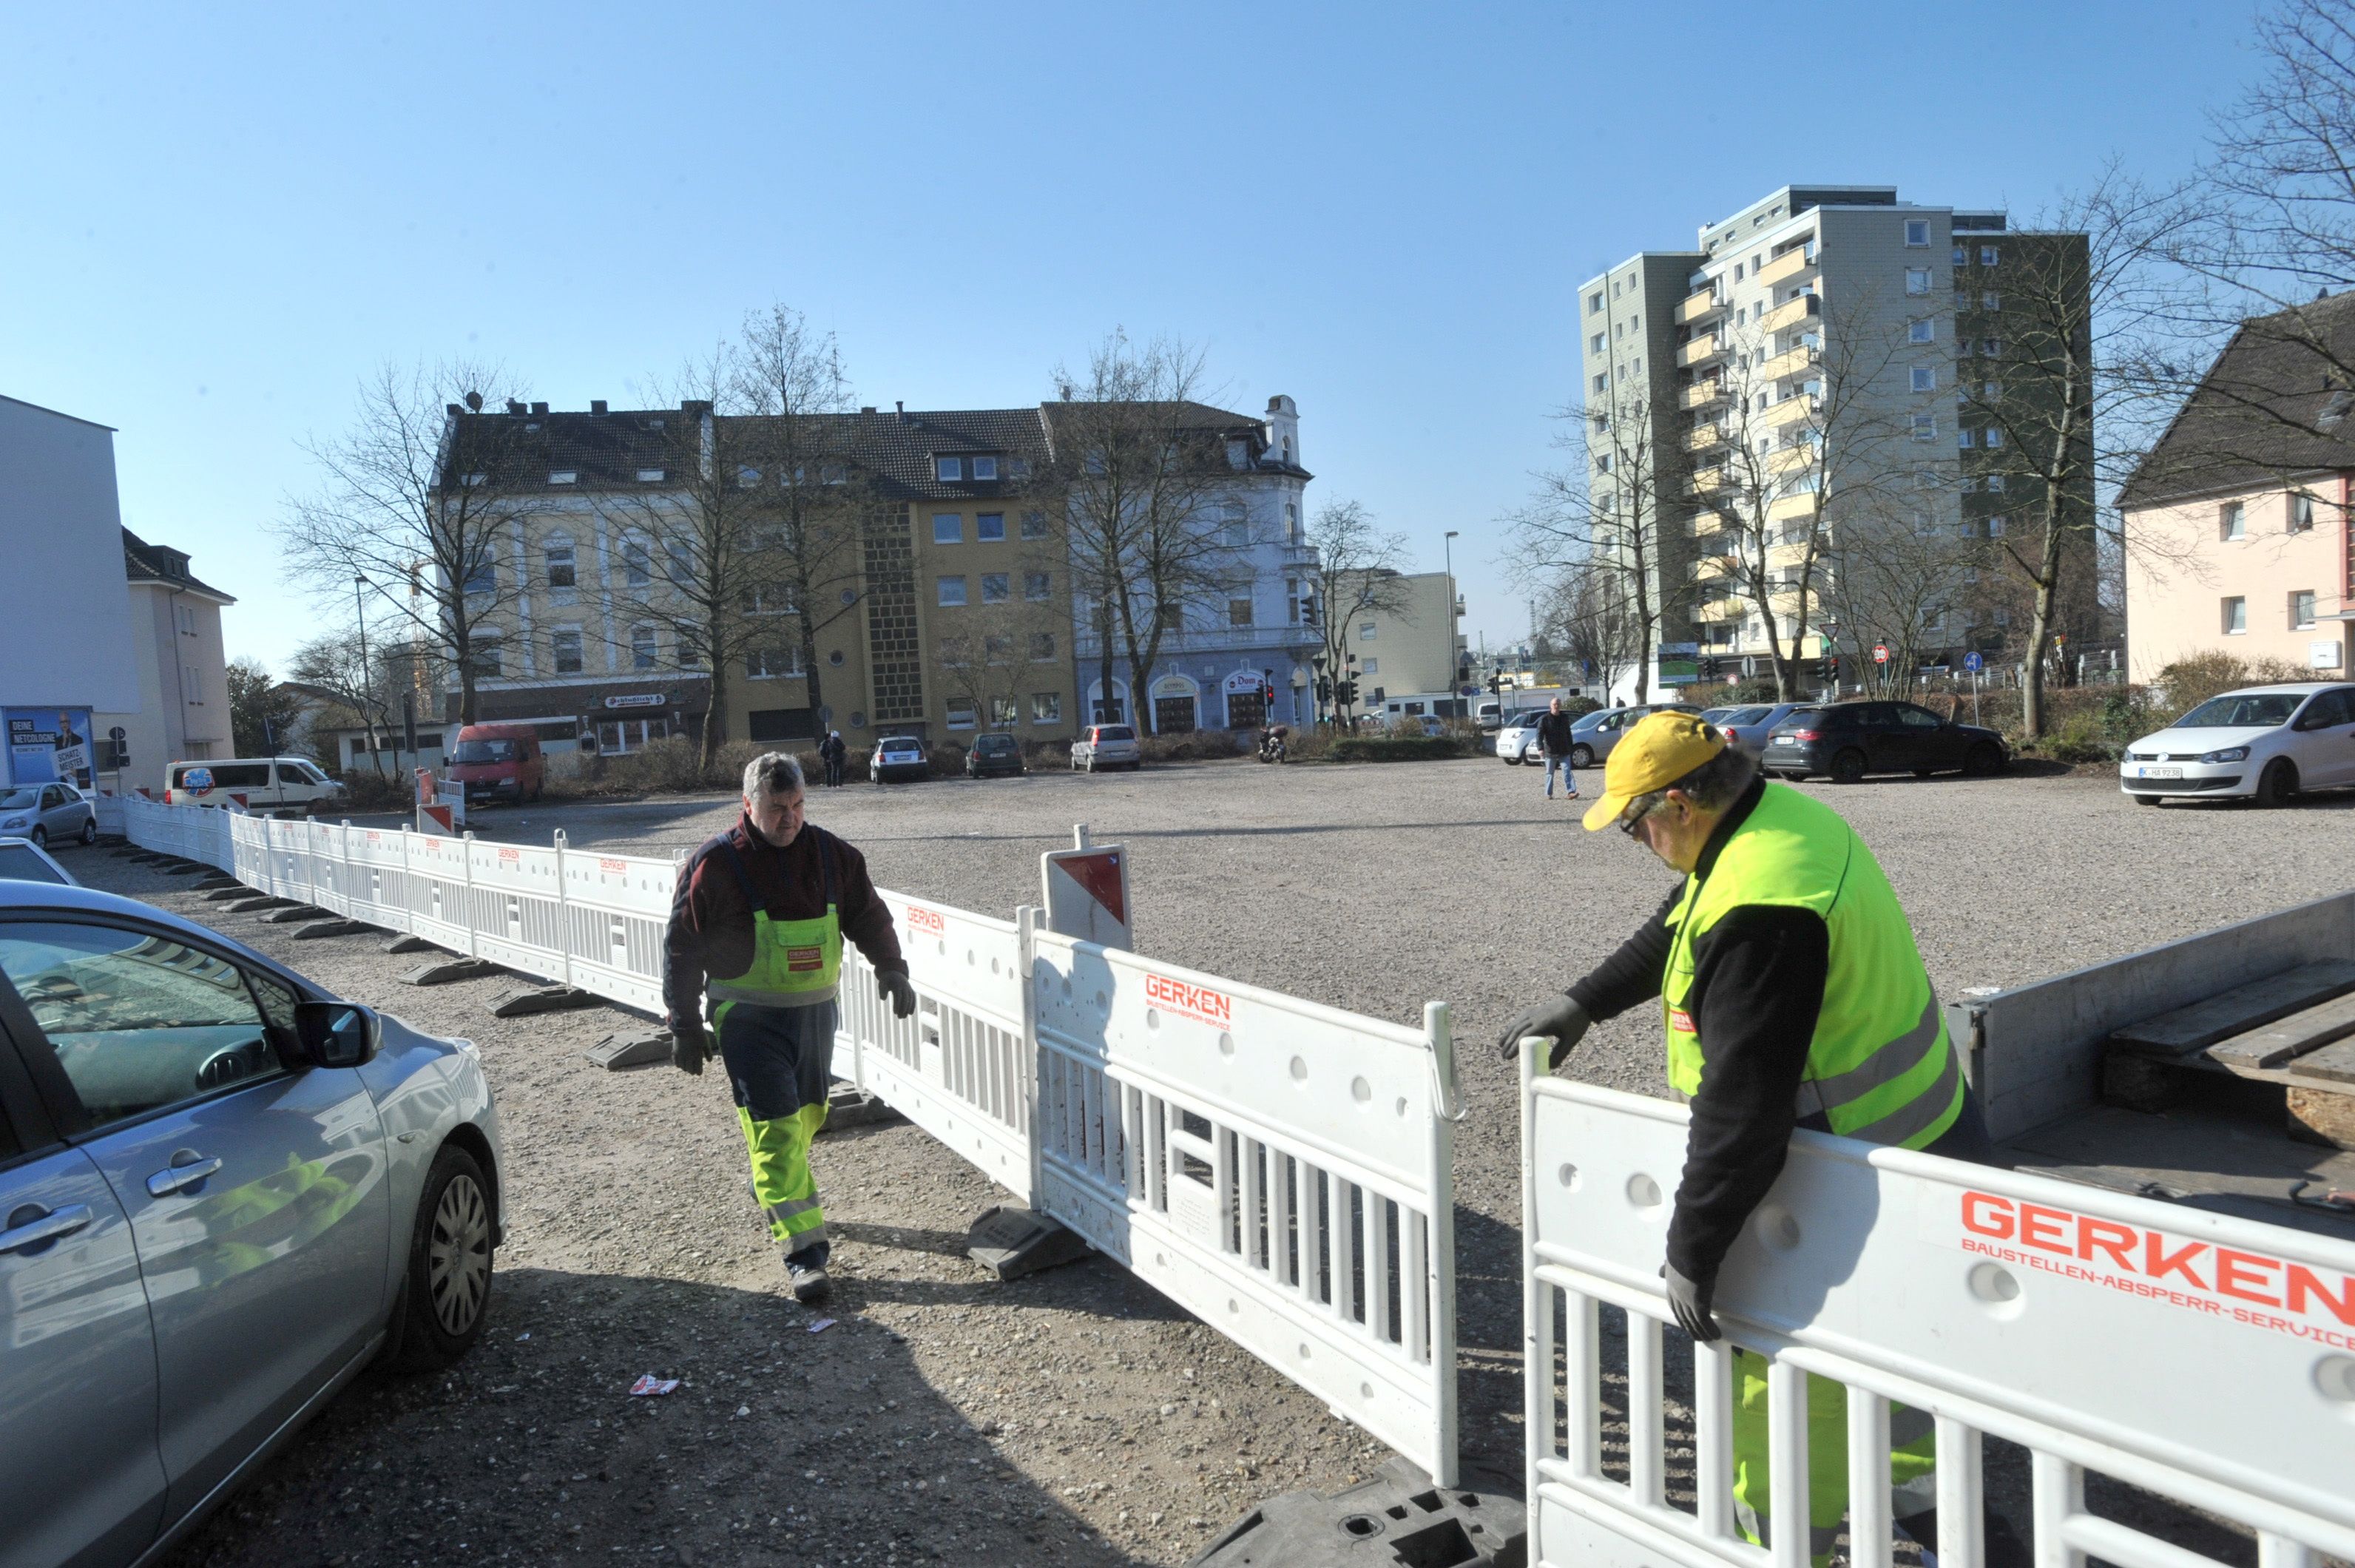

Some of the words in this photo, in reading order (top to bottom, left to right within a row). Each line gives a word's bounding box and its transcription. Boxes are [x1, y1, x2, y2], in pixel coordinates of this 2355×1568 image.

[1237, 676, 1256, 685] Dom
[12, 720, 33, 731] DEINE
[13, 733, 56, 743] NETCOLOGNE
[58, 748, 81, 763] SCHATZ-
[59, 757, 84, 770] MEISTER
[499, 848, 519, 859] GERKEN
[601, 859, 626, 871] GERKEN
[908, 906, 944, 931] GERKEN
[788, 948, 820, 958] GERKEN
[1146, 974, 1230, 1021] GERKEN
[1962, 1191, 2355, 1327] GERKEN
